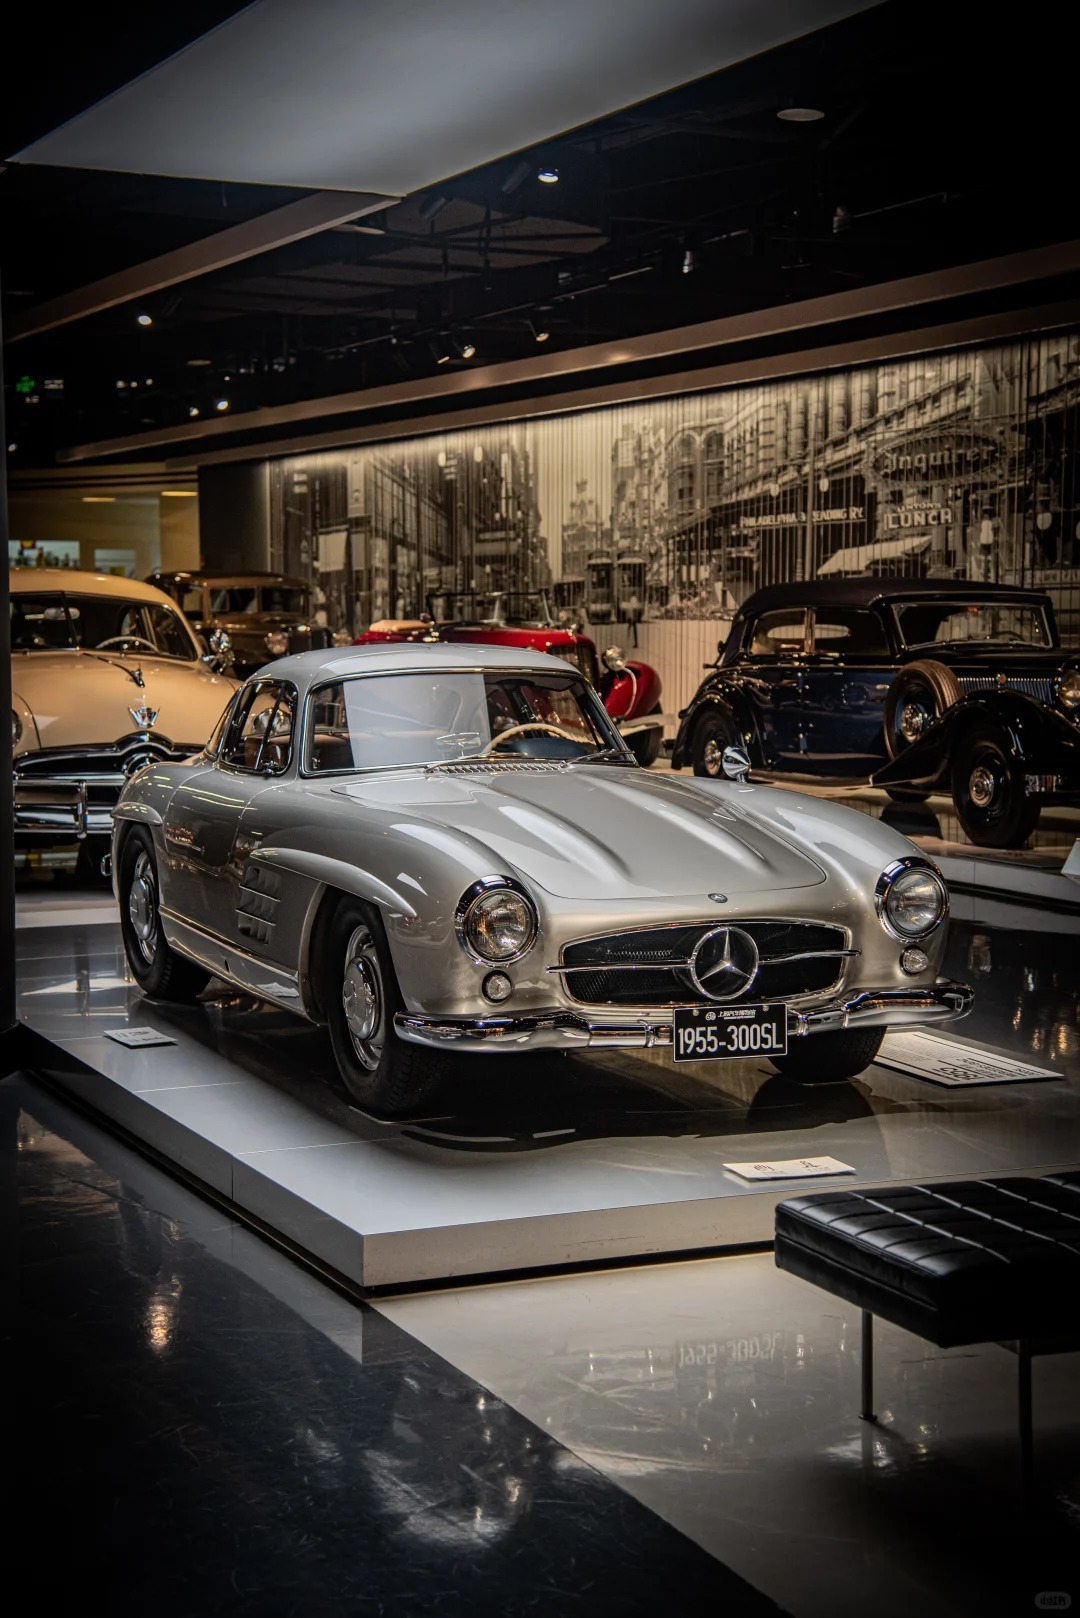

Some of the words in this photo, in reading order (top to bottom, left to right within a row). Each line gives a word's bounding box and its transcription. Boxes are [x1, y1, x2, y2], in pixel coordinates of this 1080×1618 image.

[740, 512, 797, 528] PHILADELPHIA
[884, 508, 952, 530] LUNCH
[678, 1022, 783, 1055] 1955-300SL
